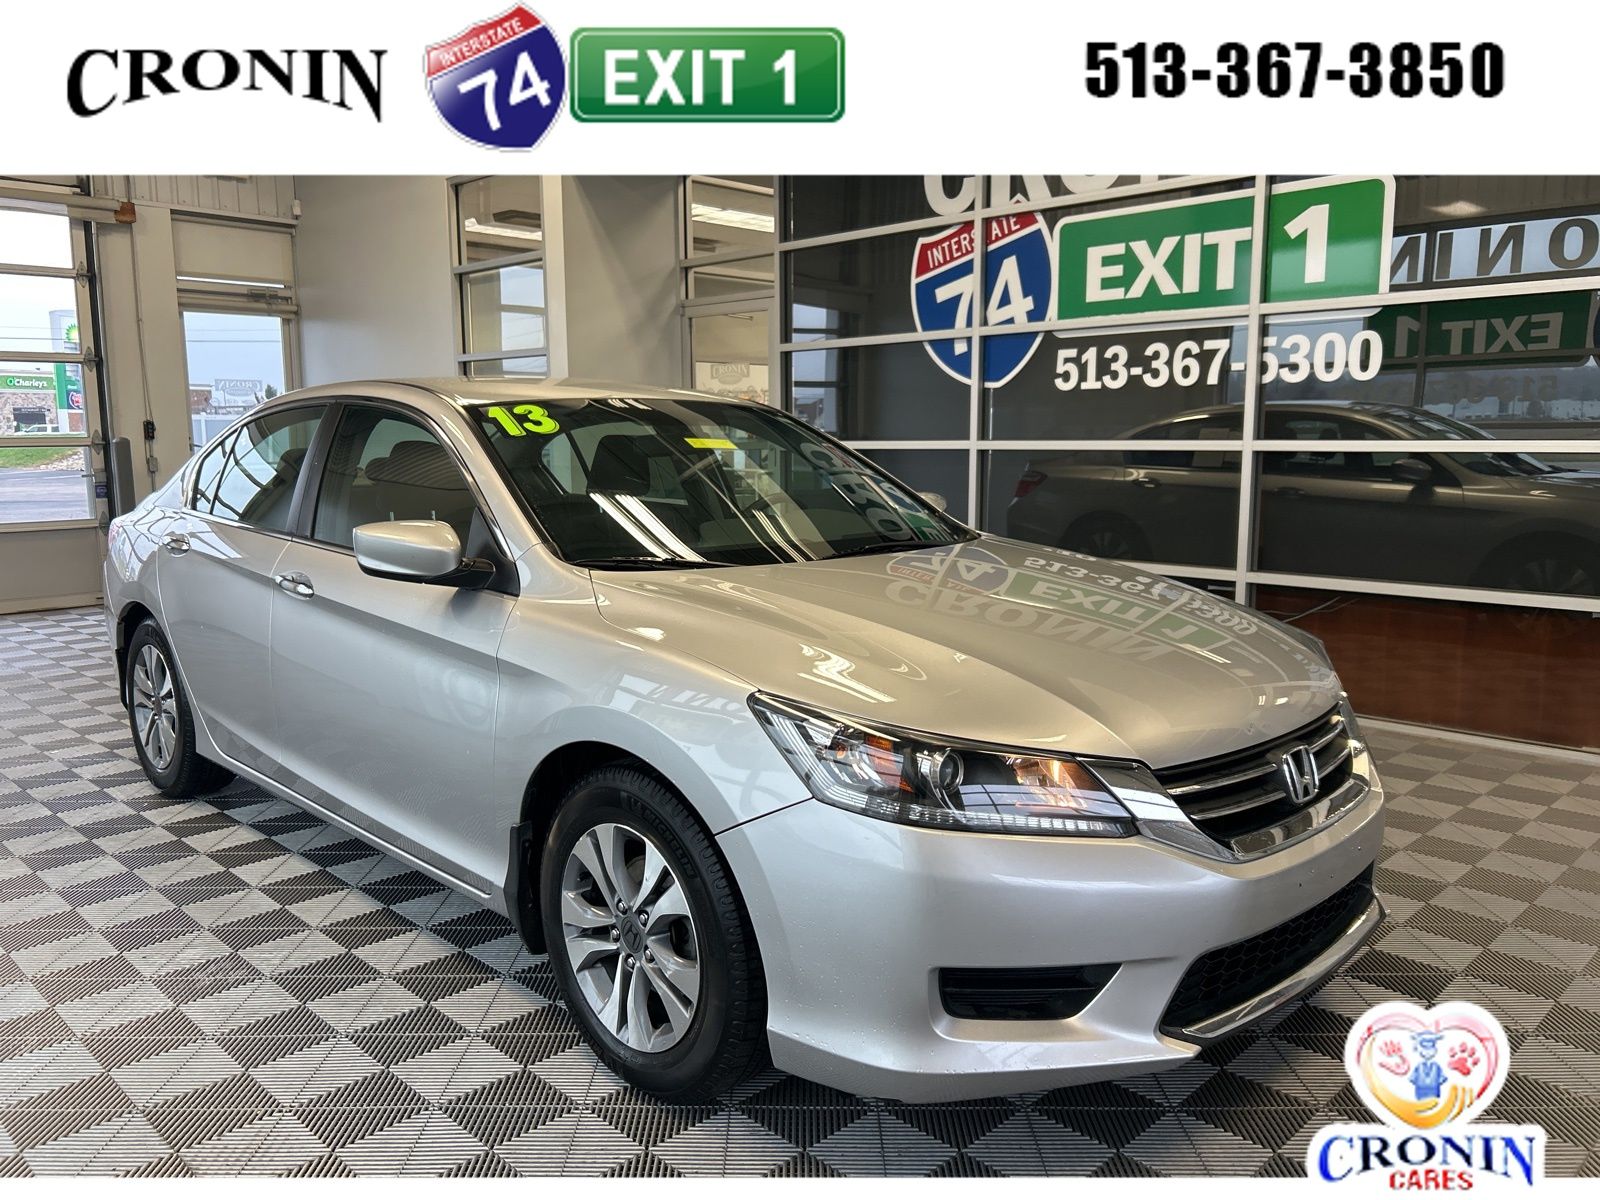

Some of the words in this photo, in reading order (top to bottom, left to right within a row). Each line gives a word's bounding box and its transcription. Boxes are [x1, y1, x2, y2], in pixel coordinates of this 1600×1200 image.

[1085, 226, 1252, 304] EXIT
[1282, 203, 1330, 284] 1
[934, 254, 1035, 357] 74
[1053, 329, 1384, 392] 513-367-5300
[487, 404, 560, 437] 13
